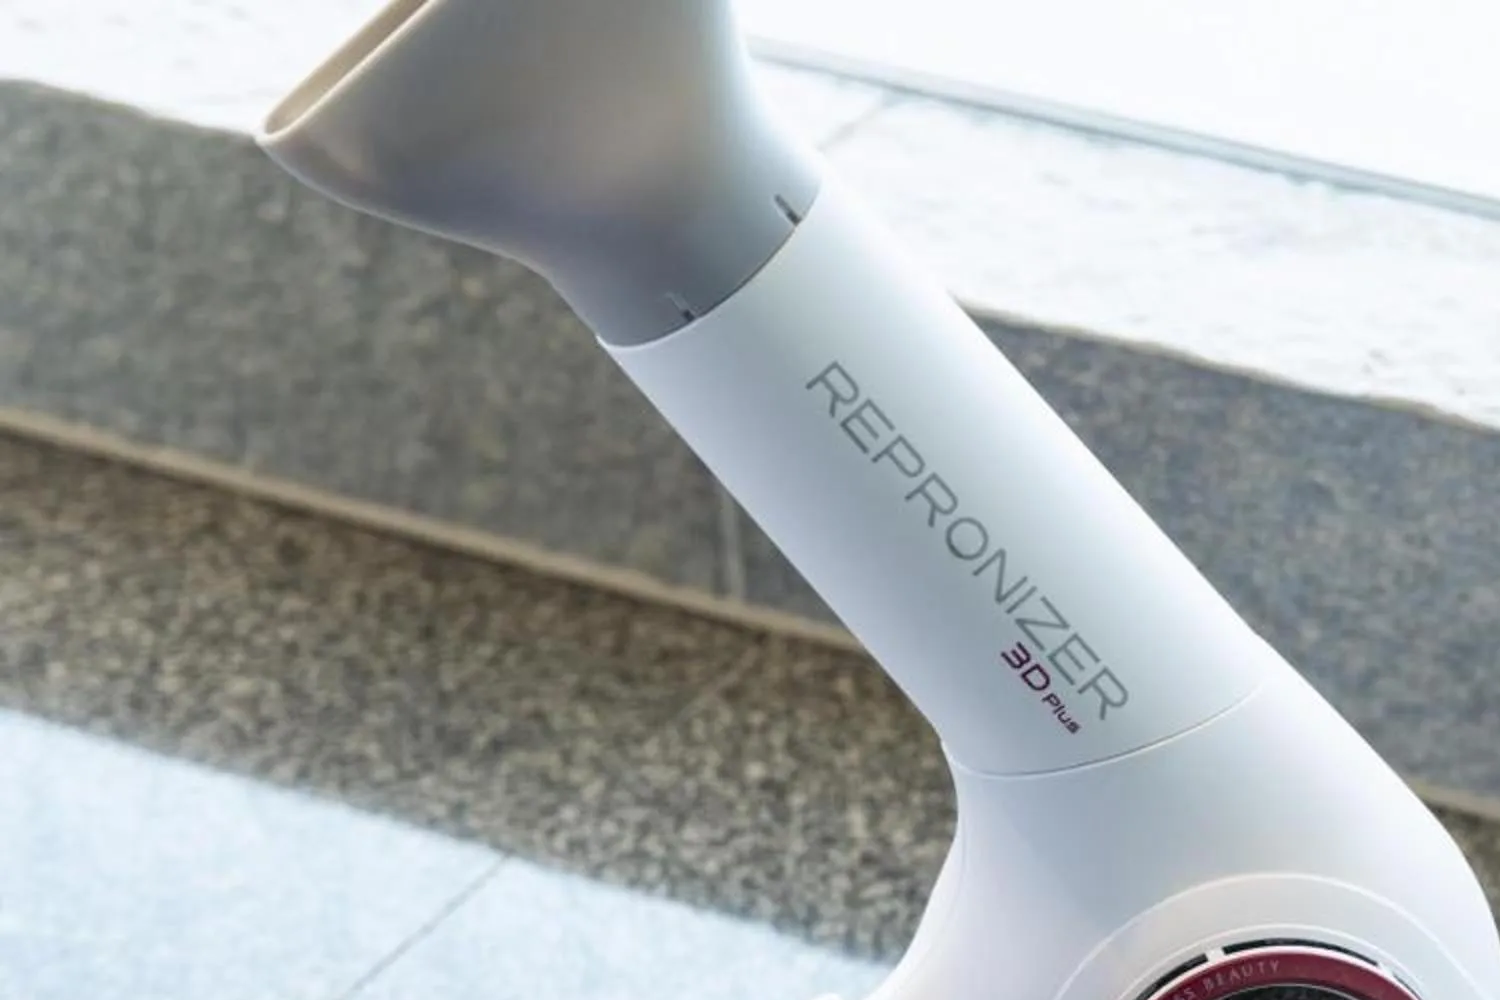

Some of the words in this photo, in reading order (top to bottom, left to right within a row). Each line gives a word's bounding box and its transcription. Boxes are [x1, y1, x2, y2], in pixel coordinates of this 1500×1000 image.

[805, 361, 1129, 721] REPRONIZER
[1000, 641, 1051, 692] 3D
[1041, 692, 1082, 735] Plus
[1202, 960, 1280, 992] BEAUTY
